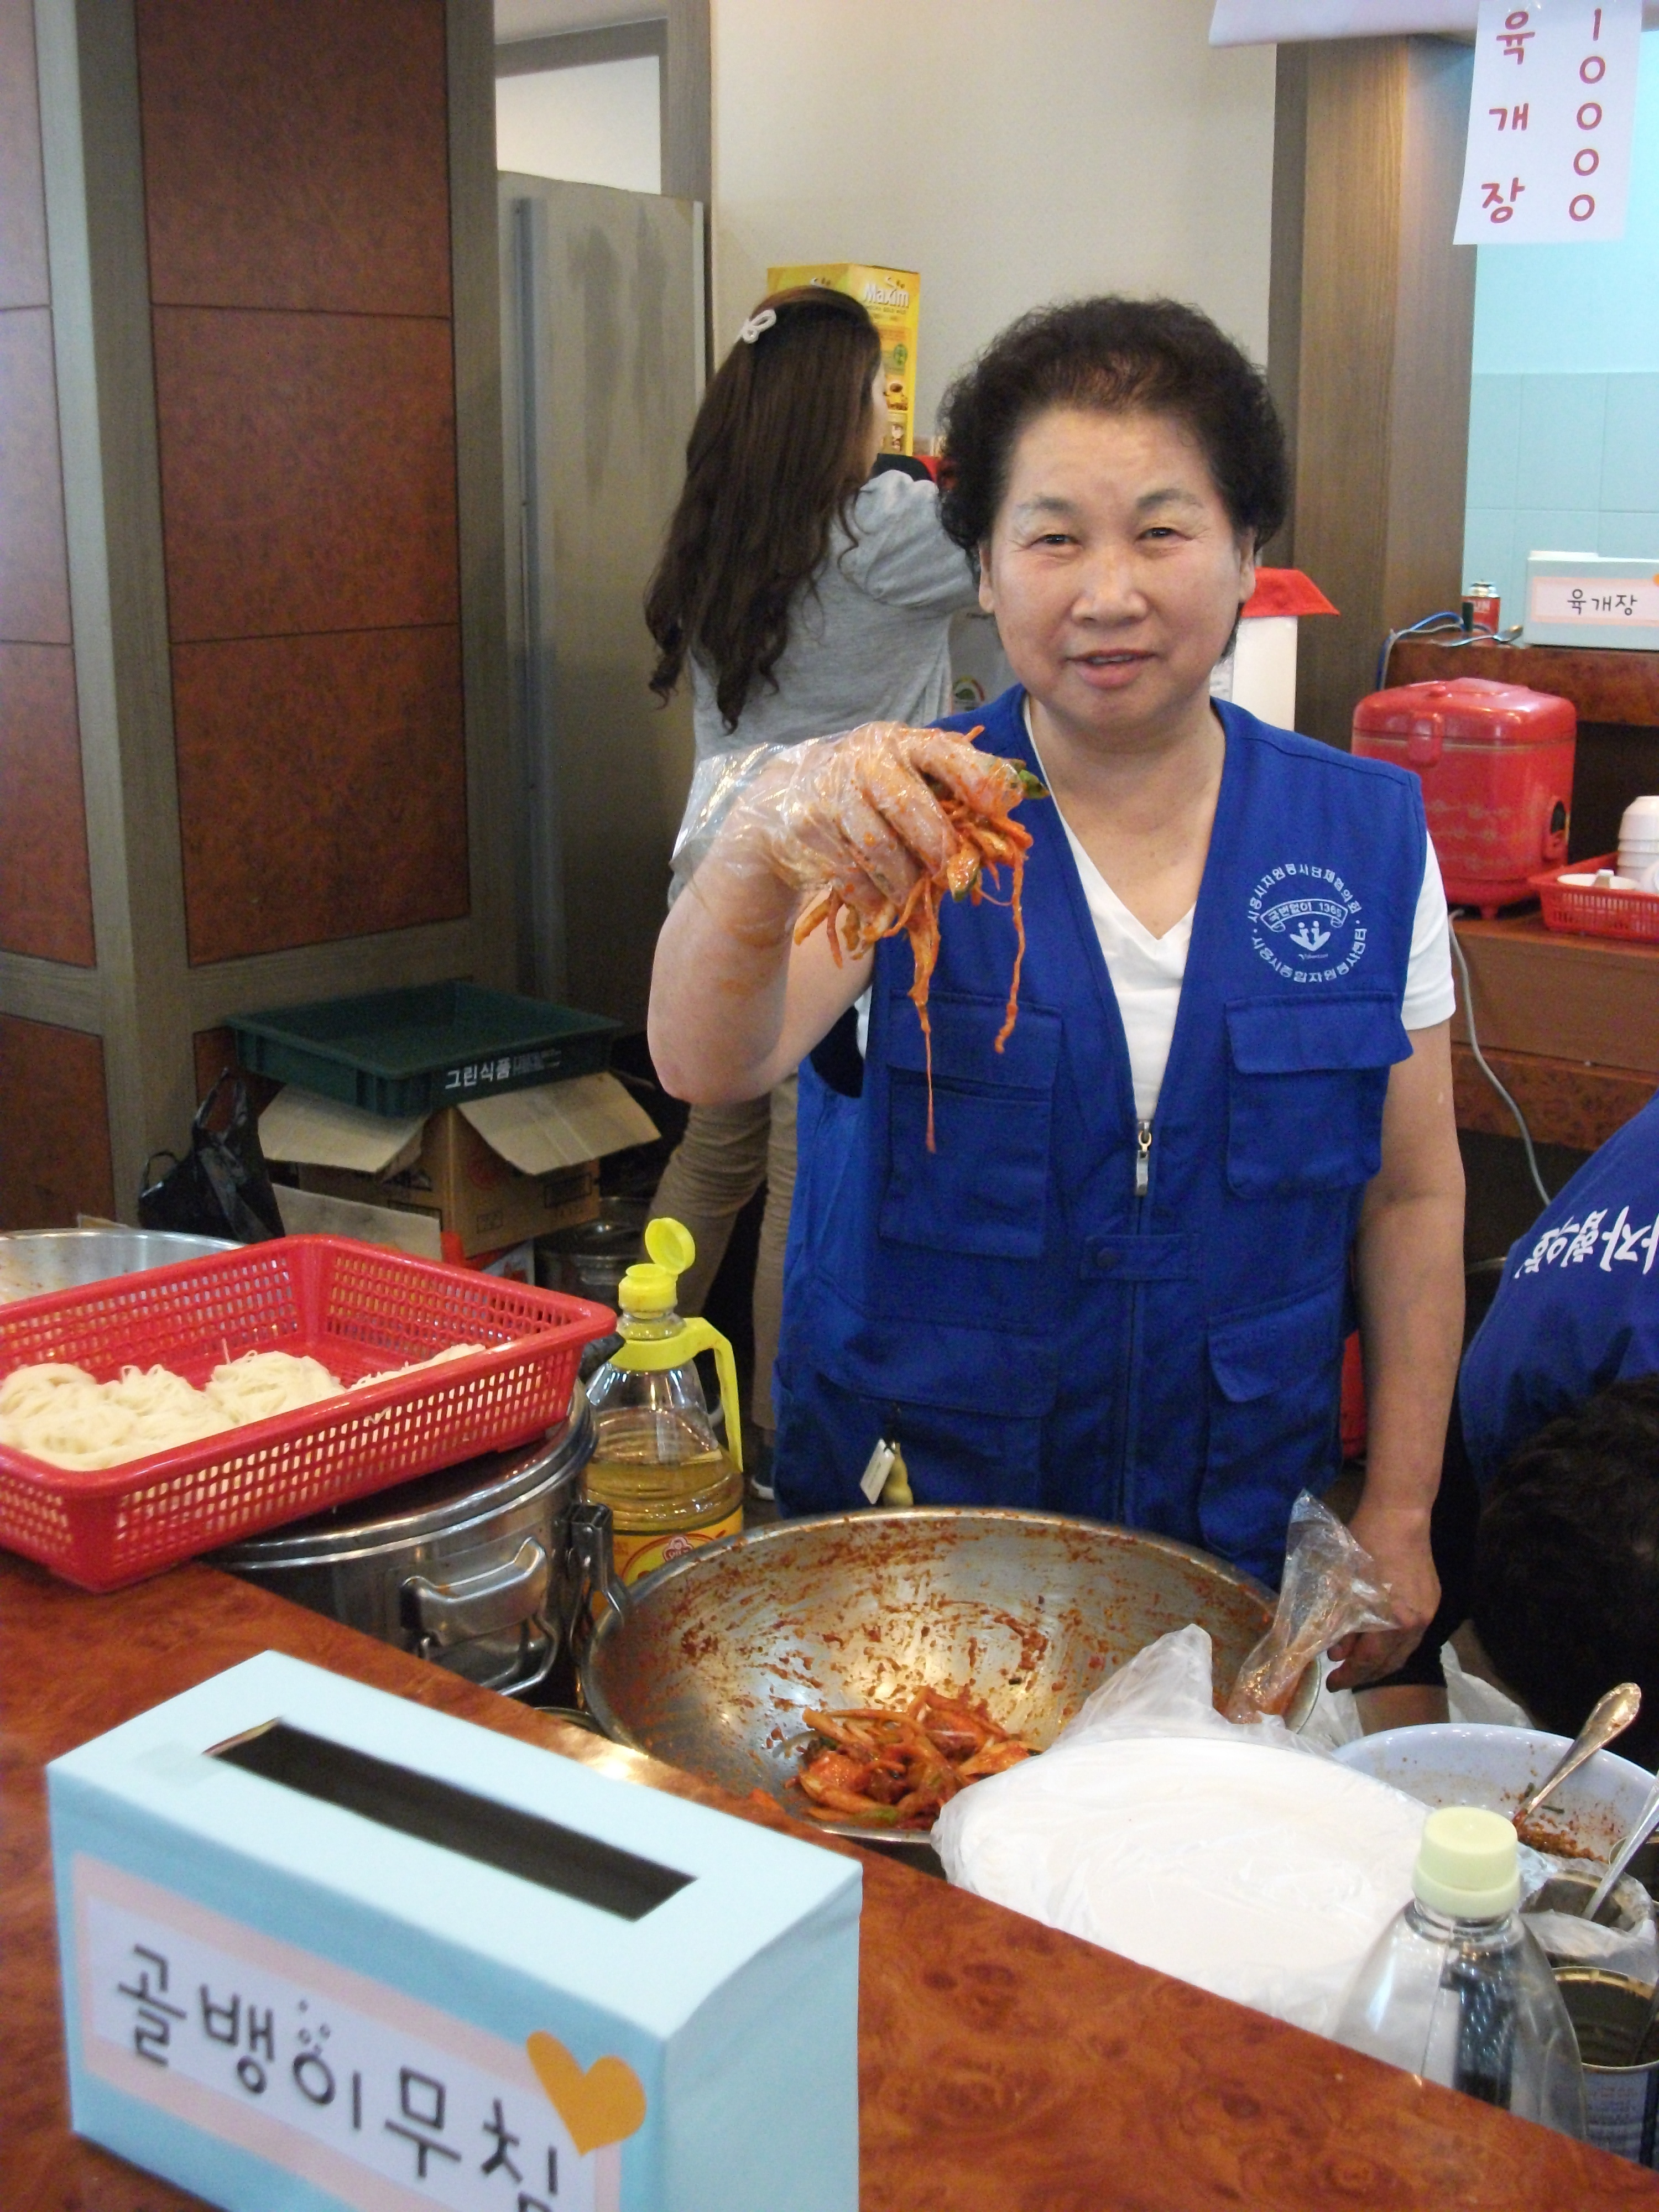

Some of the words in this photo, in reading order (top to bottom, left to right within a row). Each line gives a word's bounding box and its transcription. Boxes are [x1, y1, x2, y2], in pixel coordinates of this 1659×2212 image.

[863, 281, 910, 309] Maxim
[1567, 588, 1638, 616] 육개장
[1319, 902, 1342, 918] 1365
[445, 1057, 512, 1089] 그린식품
